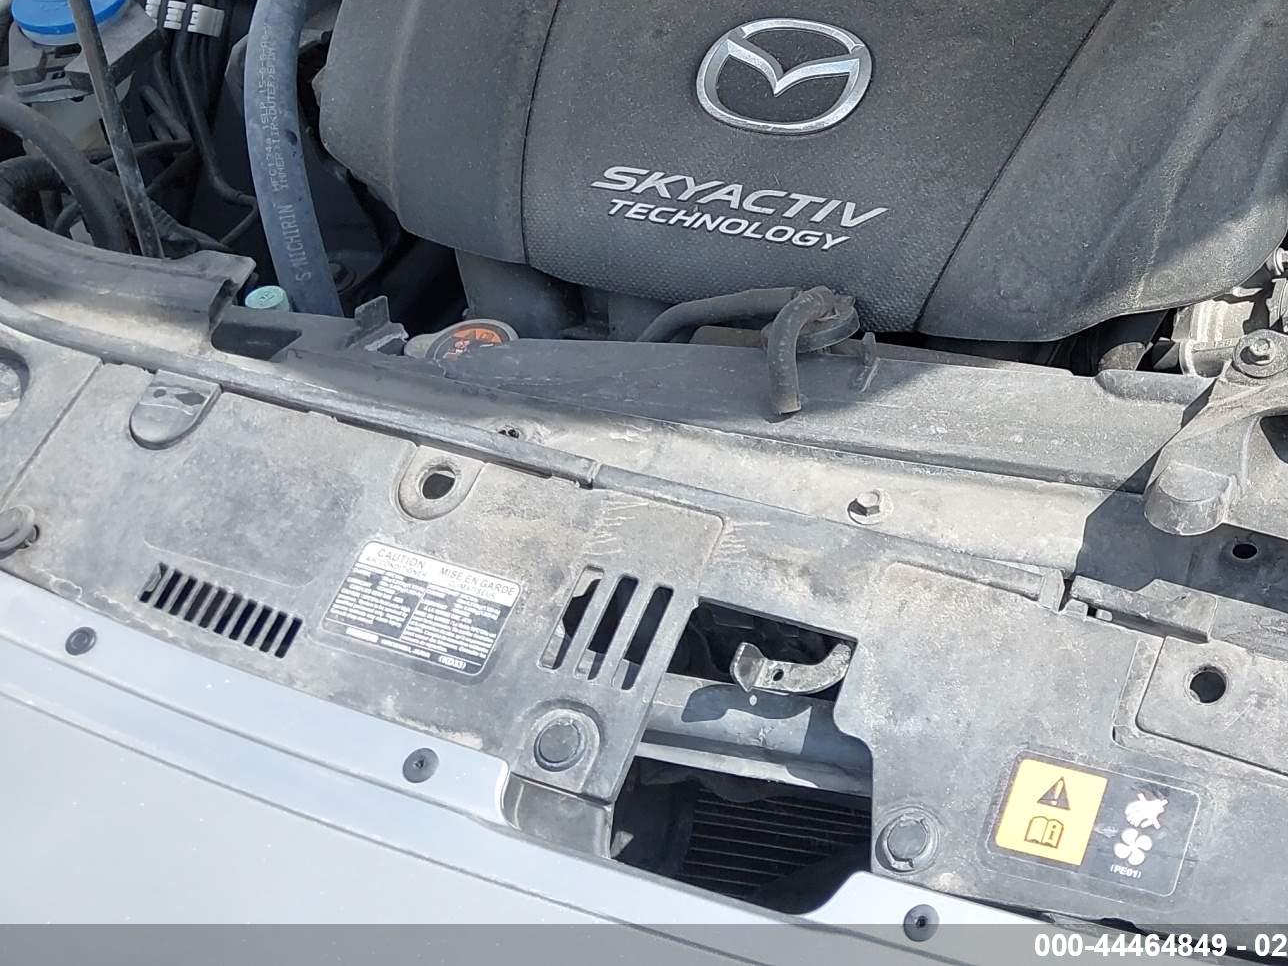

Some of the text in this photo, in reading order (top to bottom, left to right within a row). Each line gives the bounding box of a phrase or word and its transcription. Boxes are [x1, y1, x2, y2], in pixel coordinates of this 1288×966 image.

[590, 165, 889, 229] SKYACTIV
[607, 198, 851, 251] TECHNOLOGY
[377, 548, 516, 596] CAUTION MISE EN GARDE
